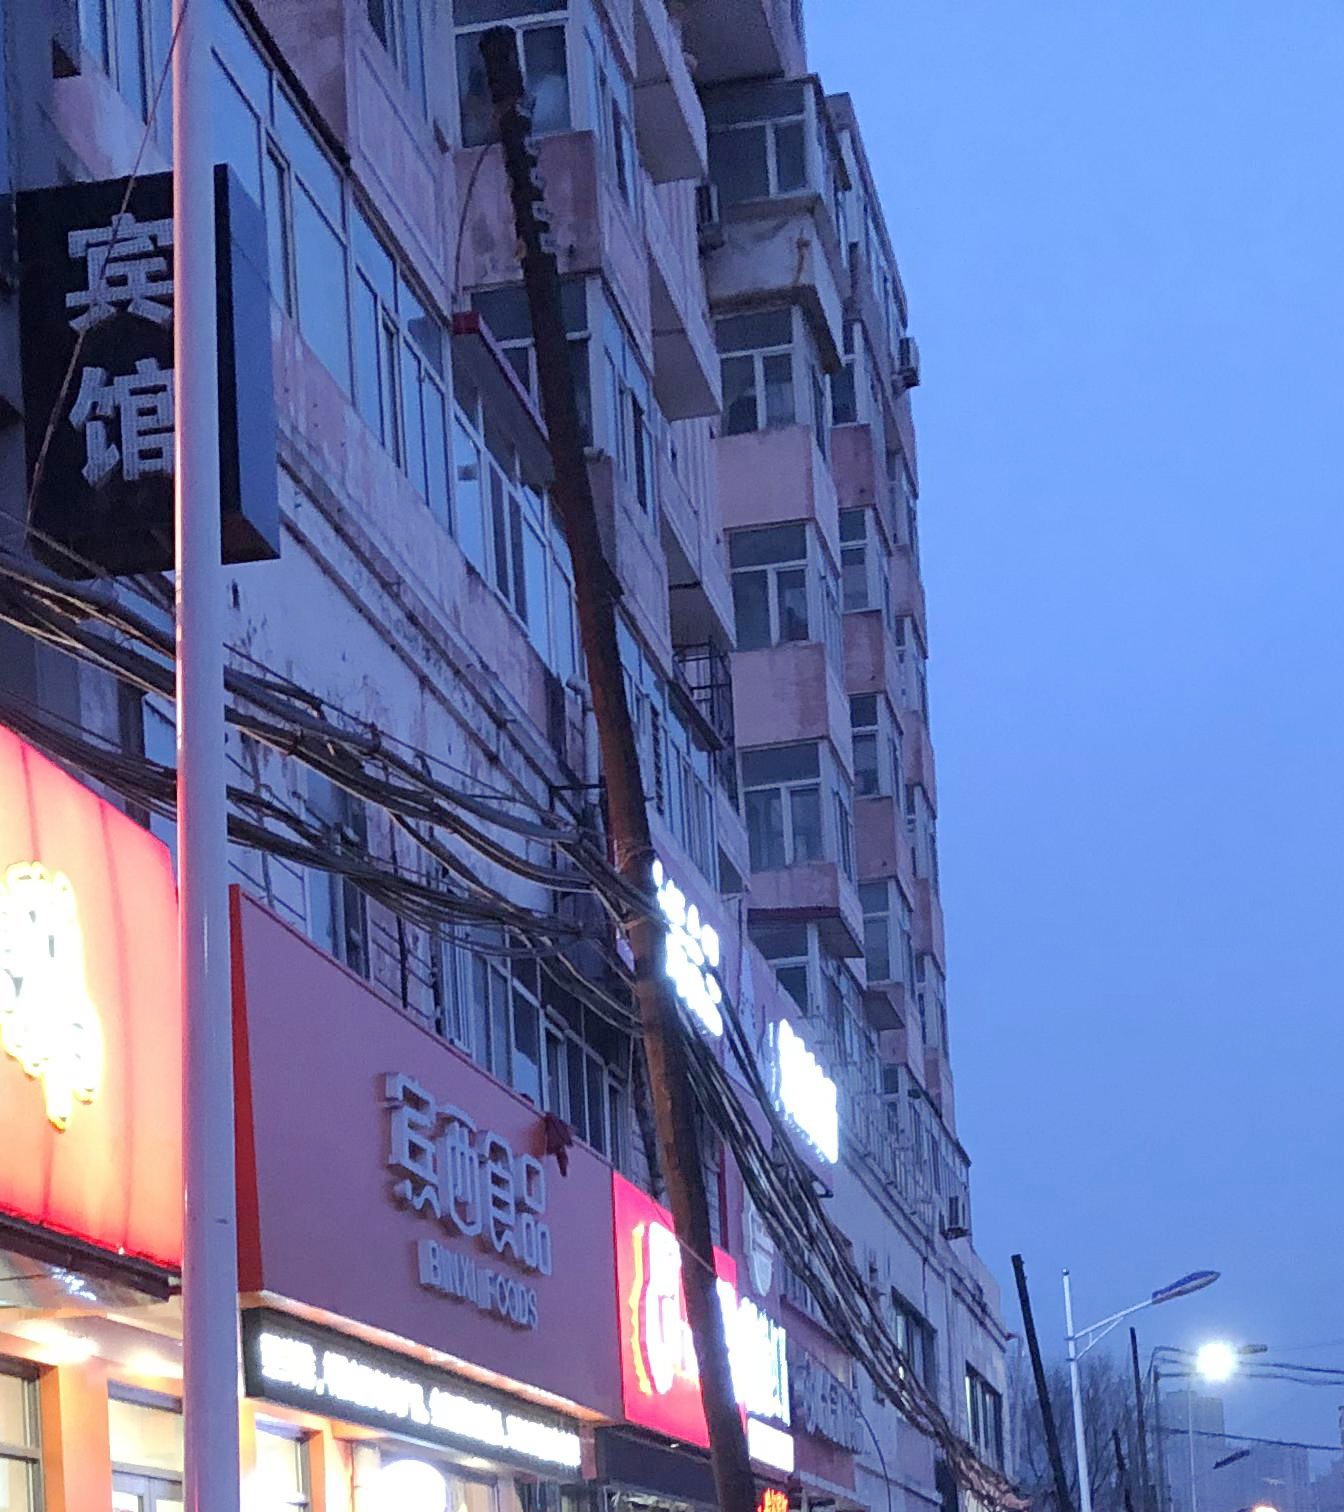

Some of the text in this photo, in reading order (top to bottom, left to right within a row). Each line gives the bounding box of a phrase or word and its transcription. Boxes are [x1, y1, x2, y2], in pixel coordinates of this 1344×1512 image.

[64, 212, 174, 487] 宾馆
[417, 1238, 539, 1330] BINXI FOODS
